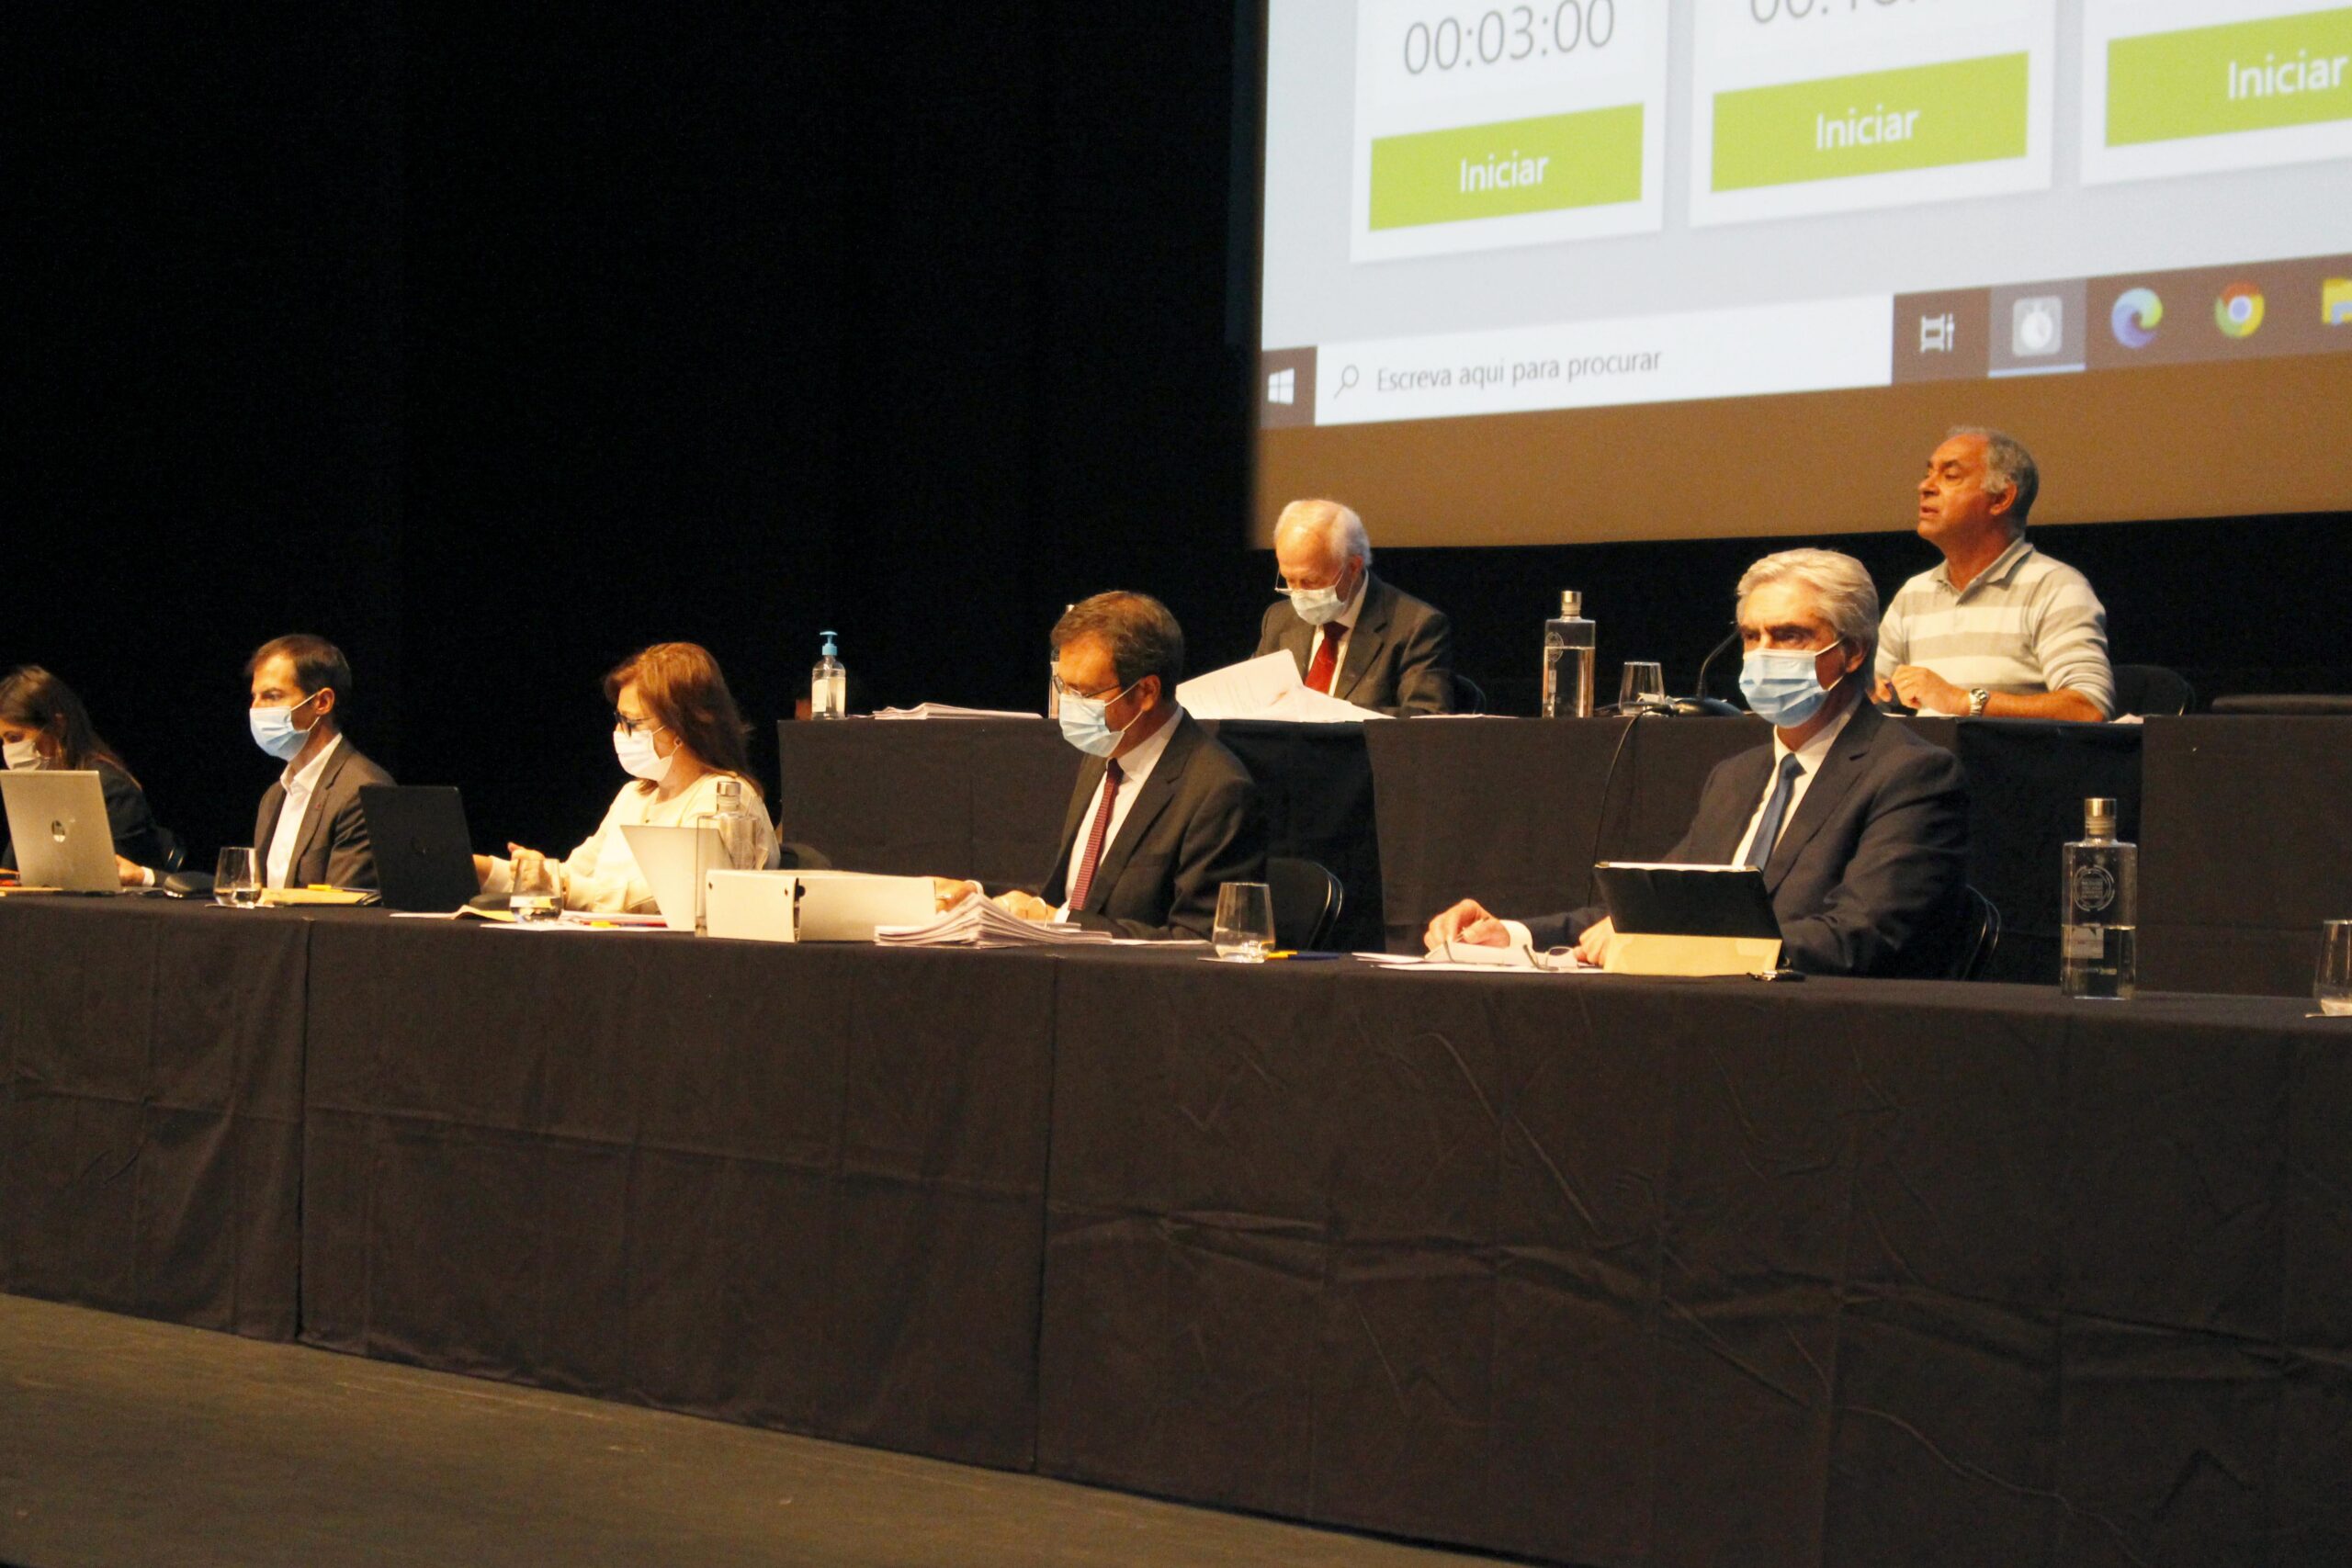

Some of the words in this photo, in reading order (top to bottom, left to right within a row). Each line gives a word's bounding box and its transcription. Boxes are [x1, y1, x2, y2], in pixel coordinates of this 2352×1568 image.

[1405, 0, 1614, 74] 00:03:00
[2228, 49, 2348, 100] Iniciar
[1815, 104, 1920, 151] Iniciar
[1460, 150, 1550, 193] Iniciar
[1378, 366, 1452, 392] Escreva
[1459, 358, 1504, 389] aqui
[1513, 359, 1560, 387] para
[1568, 351, 1662, 382] procurar
